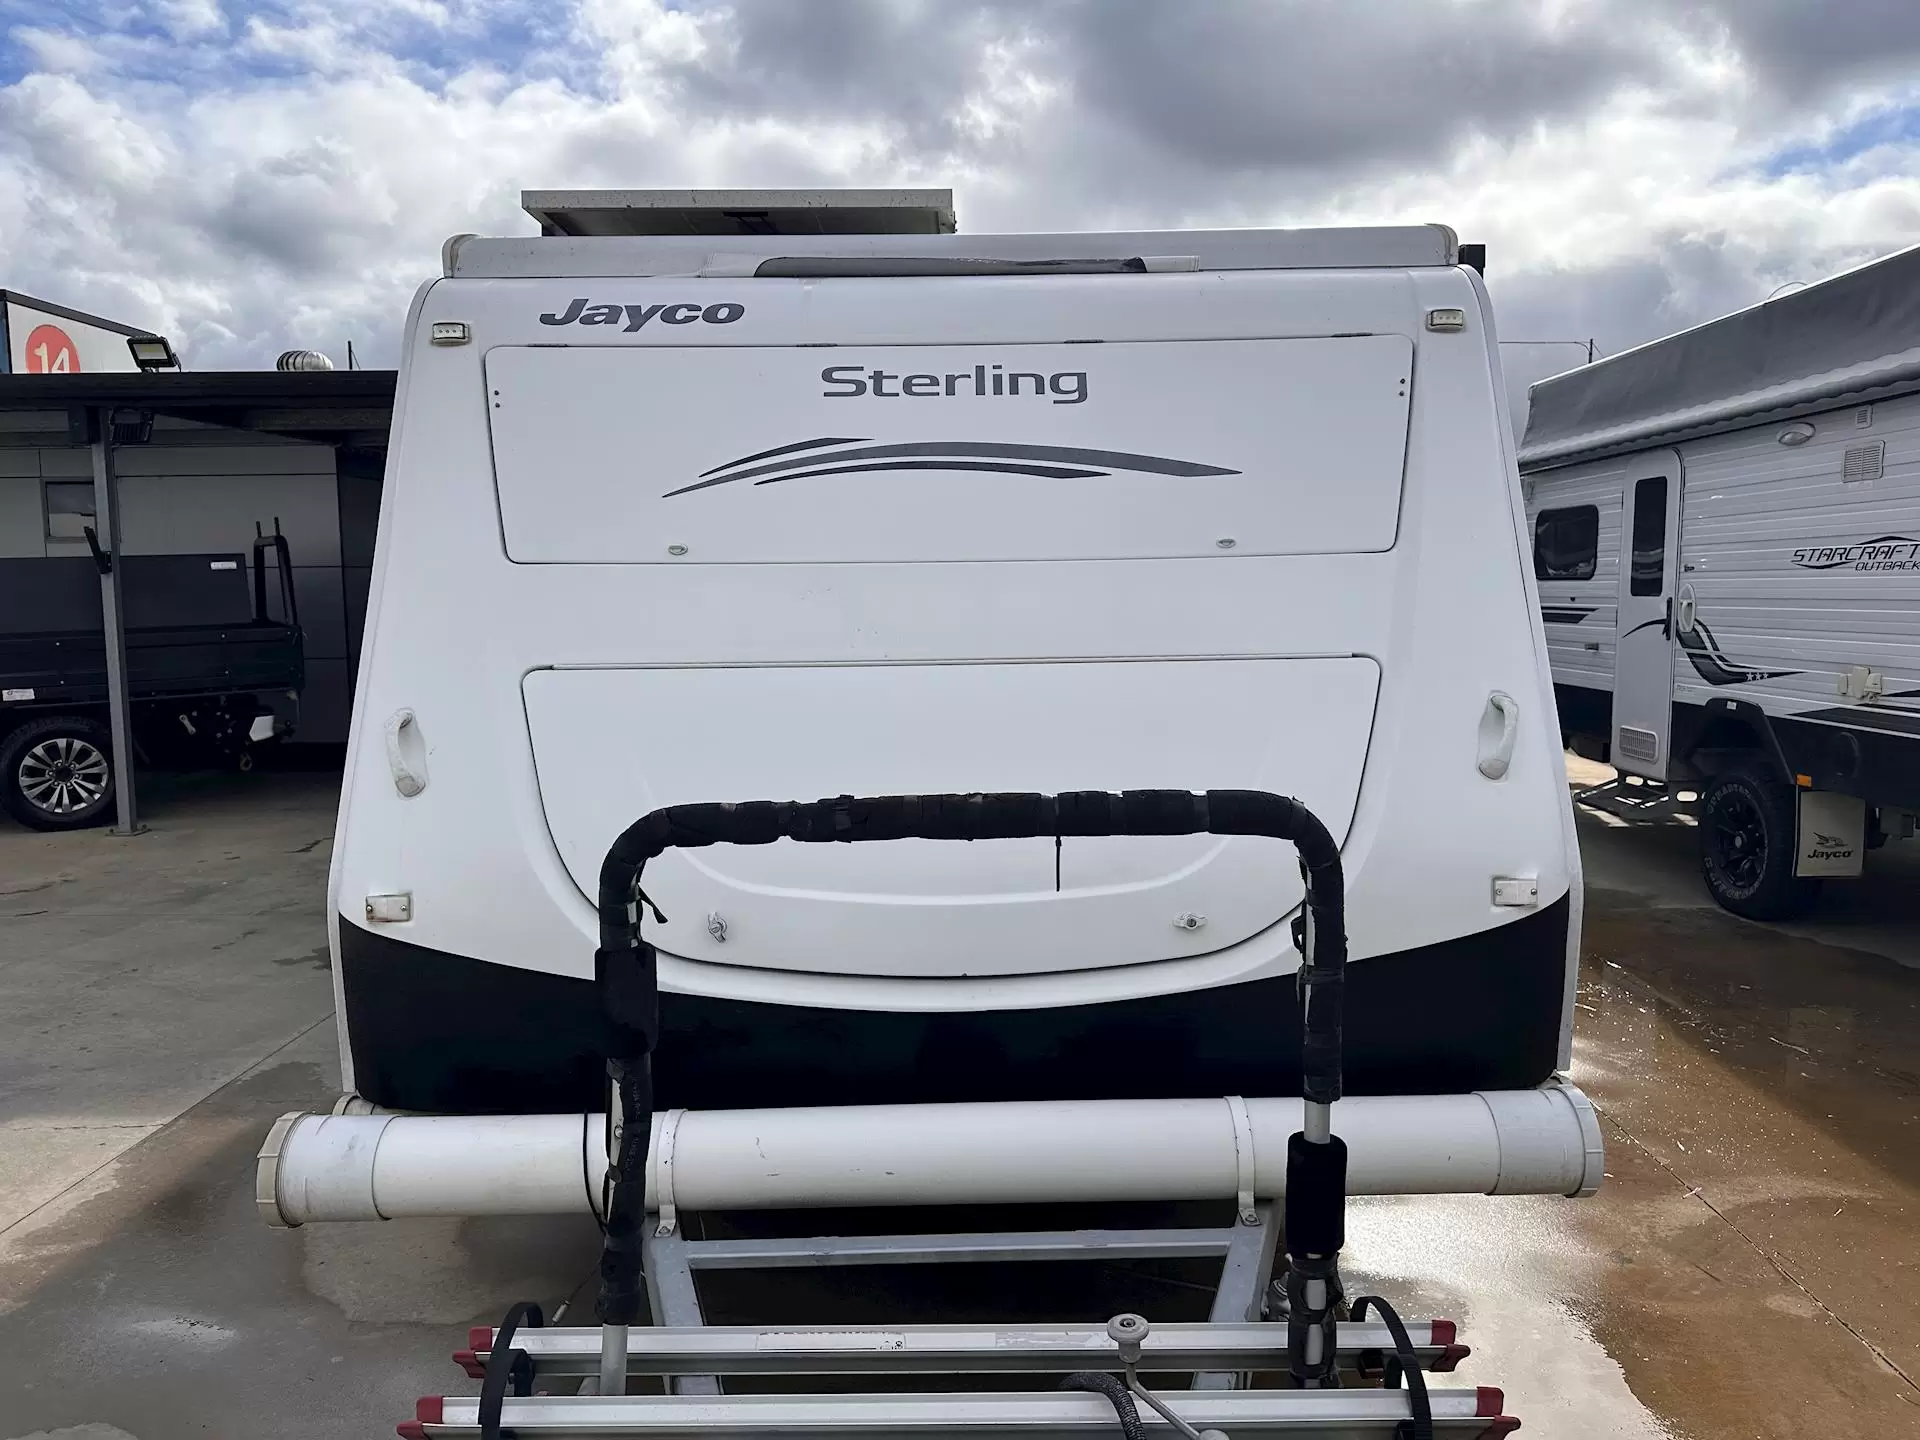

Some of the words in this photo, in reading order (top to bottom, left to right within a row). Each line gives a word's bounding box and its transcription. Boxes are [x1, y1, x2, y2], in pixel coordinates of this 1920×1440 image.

[539, 299, 744, 332] Jayco
[34, 342, 70, 374] 14
[822, 365, 1088, 404] Sterling
[1791, 544, 1920, 562] STARCRAFT
[1855, 561, 1920, 571] OUTBACK
[1807, 849, 1853, 860] Jayco
